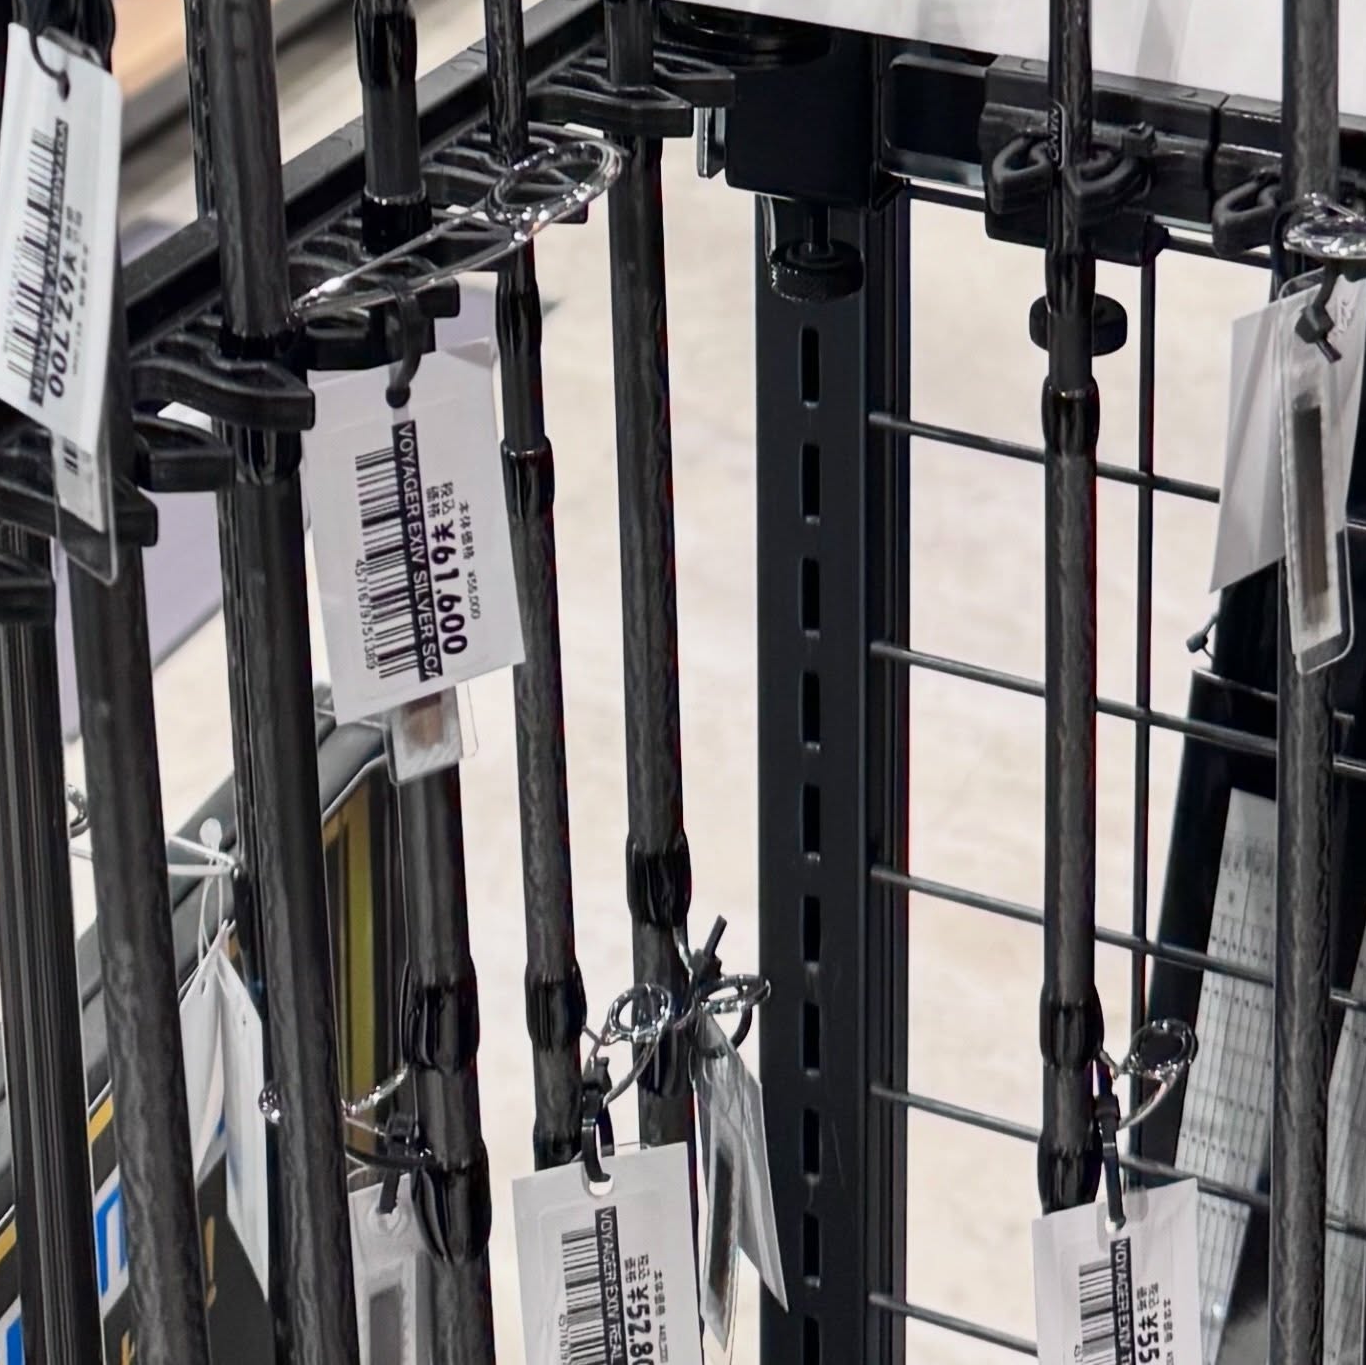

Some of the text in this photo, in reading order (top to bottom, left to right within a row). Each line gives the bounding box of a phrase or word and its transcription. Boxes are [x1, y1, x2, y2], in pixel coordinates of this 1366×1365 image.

[397, 423, 422, 518] VOYAGER
[409, 522, 428, 563] EXIV
[412, 570, 435, 639] SILVER
[430, 522, 469, 655] ¥61,600
[599, 1208, 617, 1282] VOYAGER
[1114, 1239, 1130, 1314] VOYAGER
